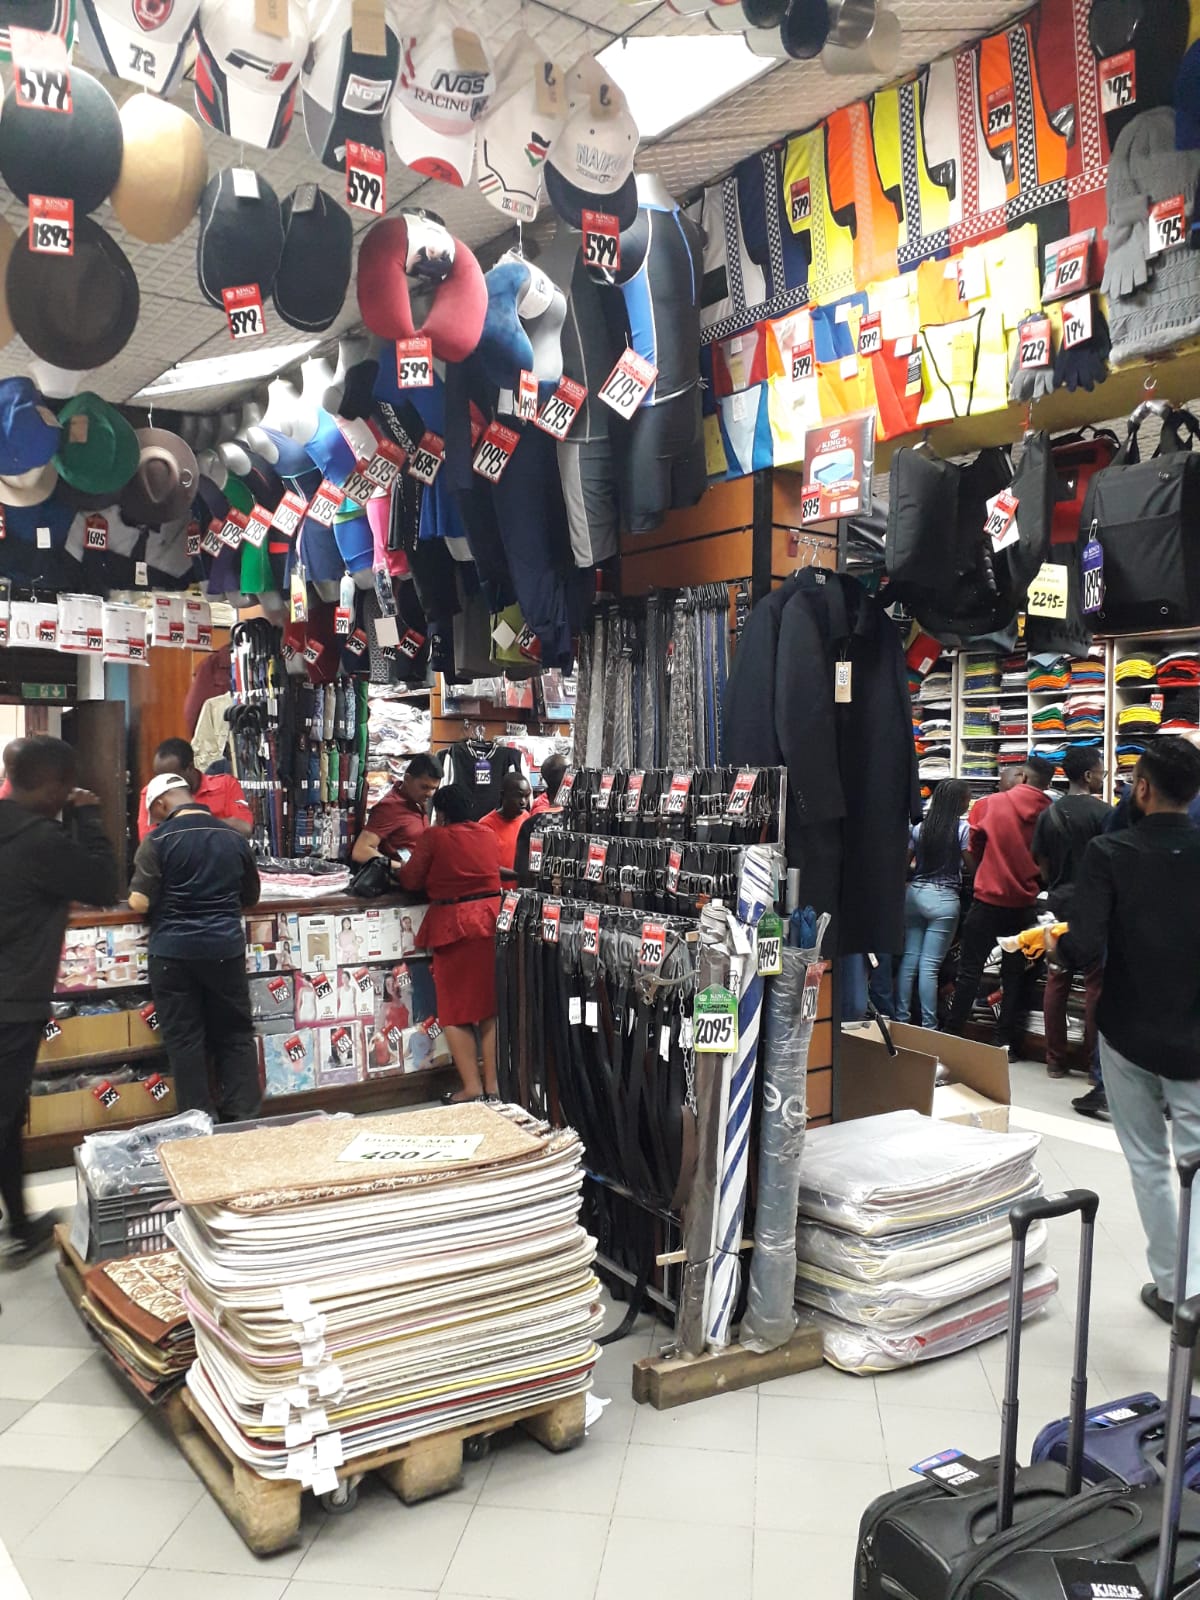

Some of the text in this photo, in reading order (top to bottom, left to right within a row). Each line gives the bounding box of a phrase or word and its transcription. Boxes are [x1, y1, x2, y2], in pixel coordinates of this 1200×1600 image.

[129, 43, 156, 79] 72
[413, 87, 468, 113] RACING
[346, 171, 381, 211] 599
[34, 221, 72, 250] 1895
[585, 234, 618, 266] 599
[1022, 341, 1046, 363] 229
[400, 362, 429, 380] 599
[793, 356, 811, 379] 599
[802, 498, 819, 519] 895
[641, 943, 662, 962] 895
[695, 1017, 733, 1044] 2095
[1090, 1583, 1143, 1599] KING'S
